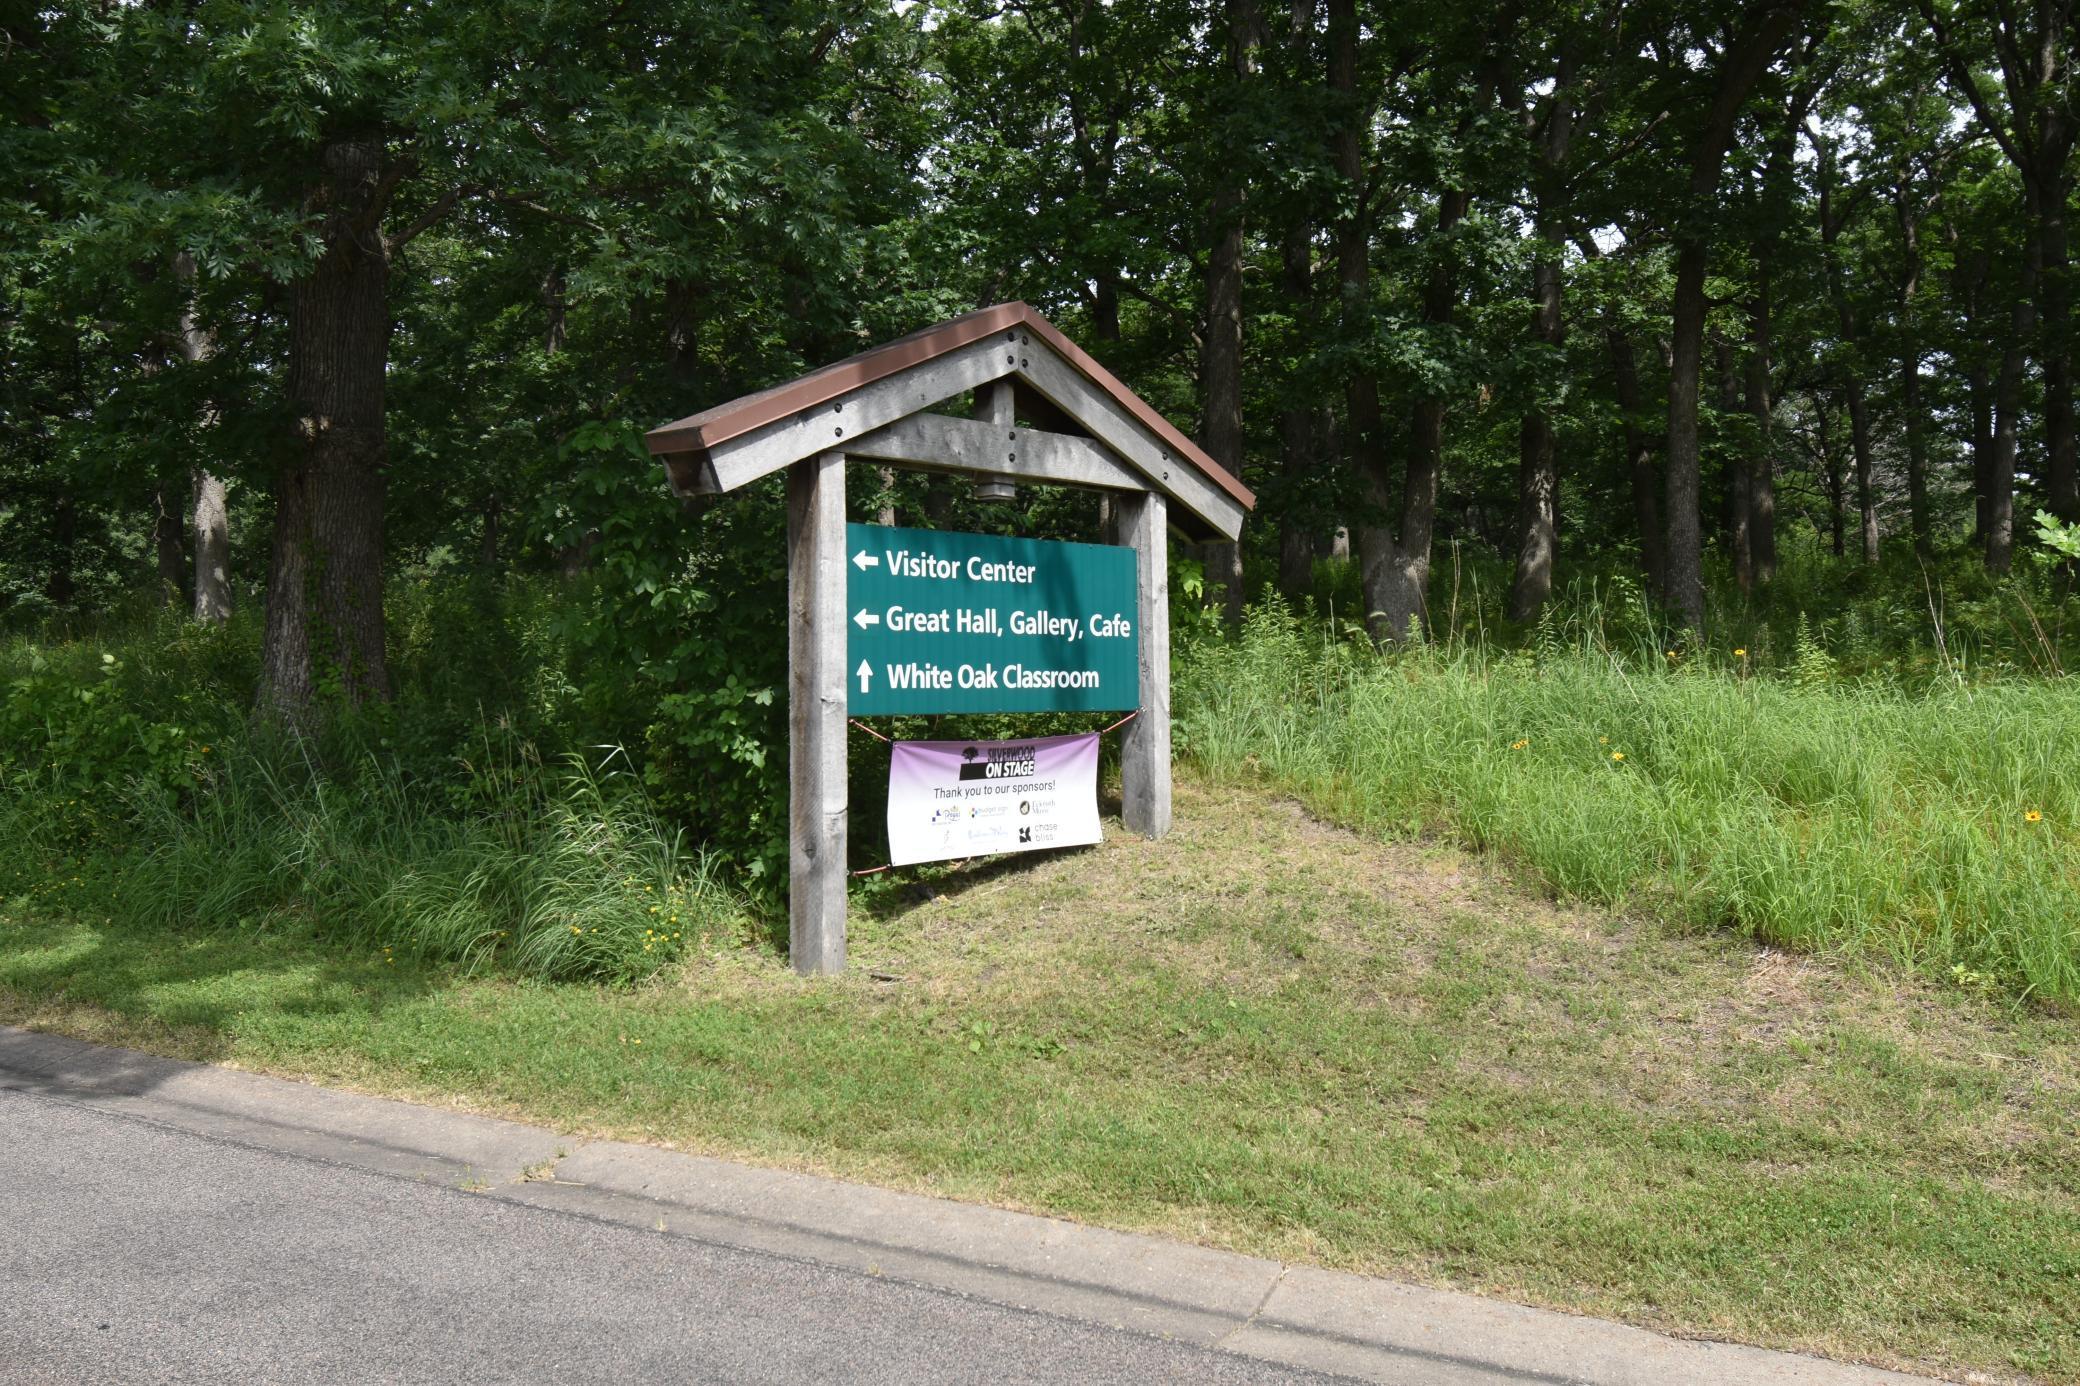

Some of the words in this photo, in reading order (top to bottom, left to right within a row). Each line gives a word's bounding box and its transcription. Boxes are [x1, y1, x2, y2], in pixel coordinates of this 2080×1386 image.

[886, 550, 960, 579] Visitor
[967, 556, 1036, 583] Center
[886, 606, 950, 632] Great
[956, 608, 1003, 637] Hall,
[1010, 611, 1084, 642] Gallery,
[1089, 613, 1131, 638] Cafe
[887, 662, 952, 689] White
[958, 664, 998, 689] Oak
[1002, 664, 1099, 689] Classroom
[987, 746, 1035, 762] SILVERWOOD
[985, 762, 1002, 778] ON
[1003, 760, 1035, 777] STAGE
[934, 786, 962, 799] Thank
[965, 787, 981, 800] you
[984, 785, 993, 795] to
[995, 785, 1010, 794] our
[1012, 779, 1056, 795] sponsors!
